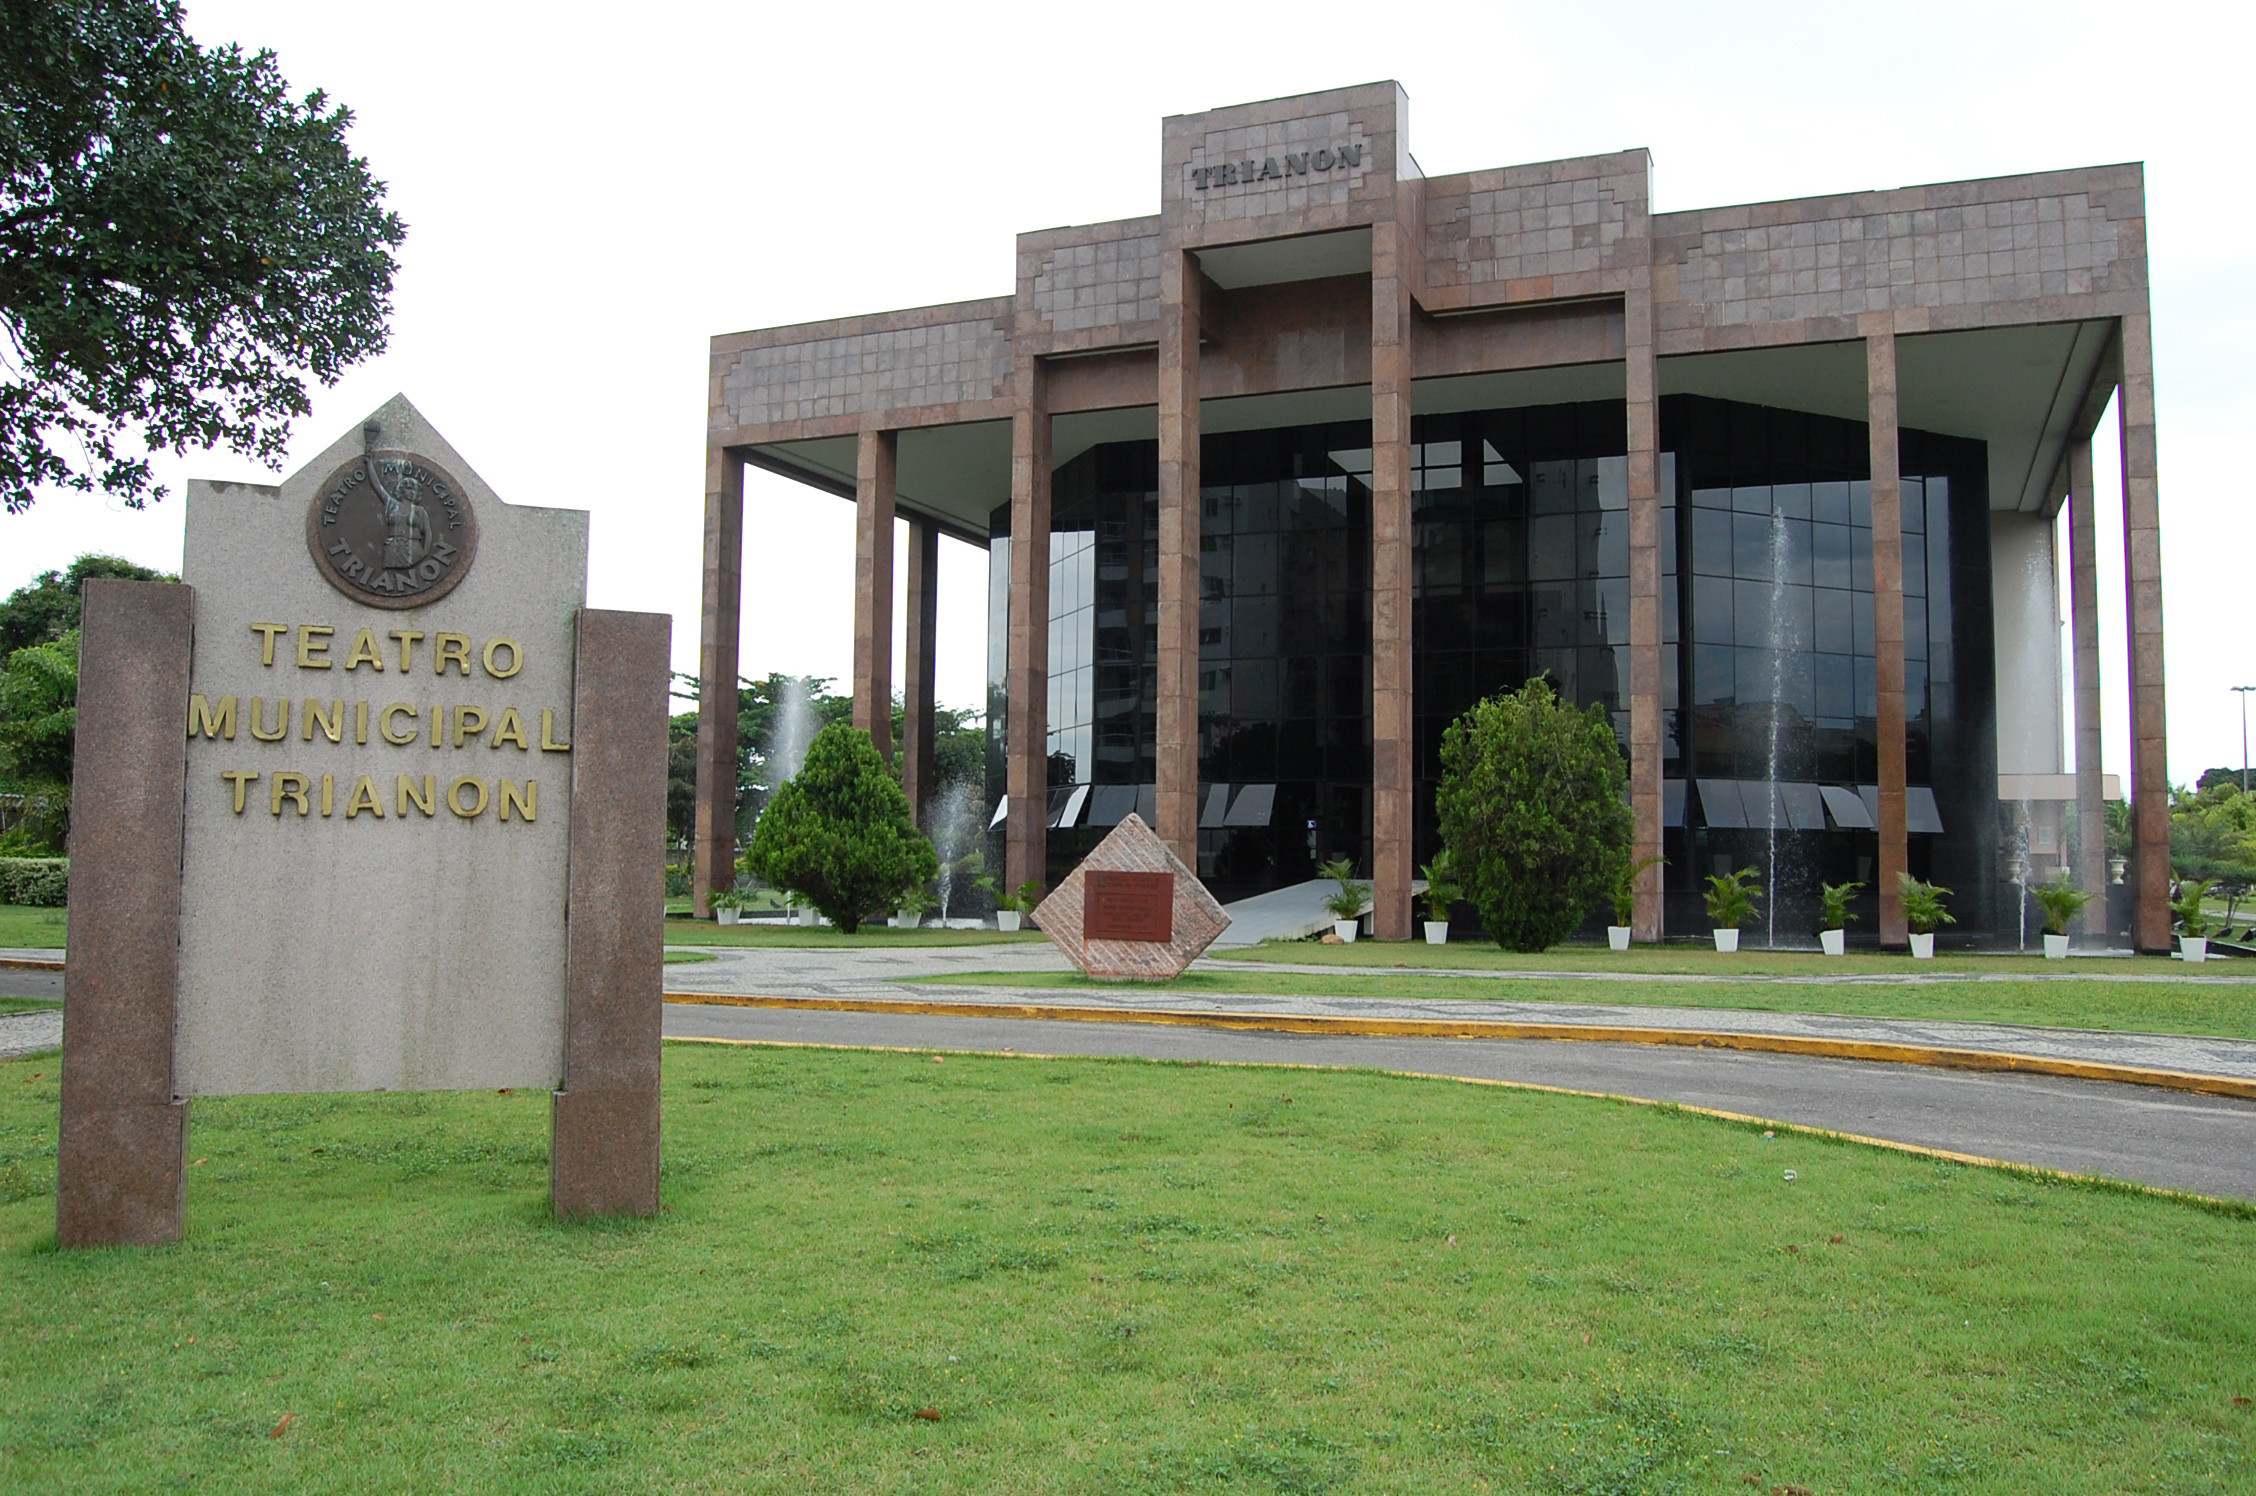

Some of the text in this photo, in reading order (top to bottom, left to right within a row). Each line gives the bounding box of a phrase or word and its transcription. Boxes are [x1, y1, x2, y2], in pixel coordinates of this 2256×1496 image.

[1191, 143, 1362, 190] TRIANON
[324, 461, 461, 530] TEATRO MUNICIPAL
[329, 538, 457, 592] TRIANON
[250, 622, 524, 678] TEATRO
[188, 694, 571, 751] MUNICIPAL
[222, 771, 537, 821] TRIANON
